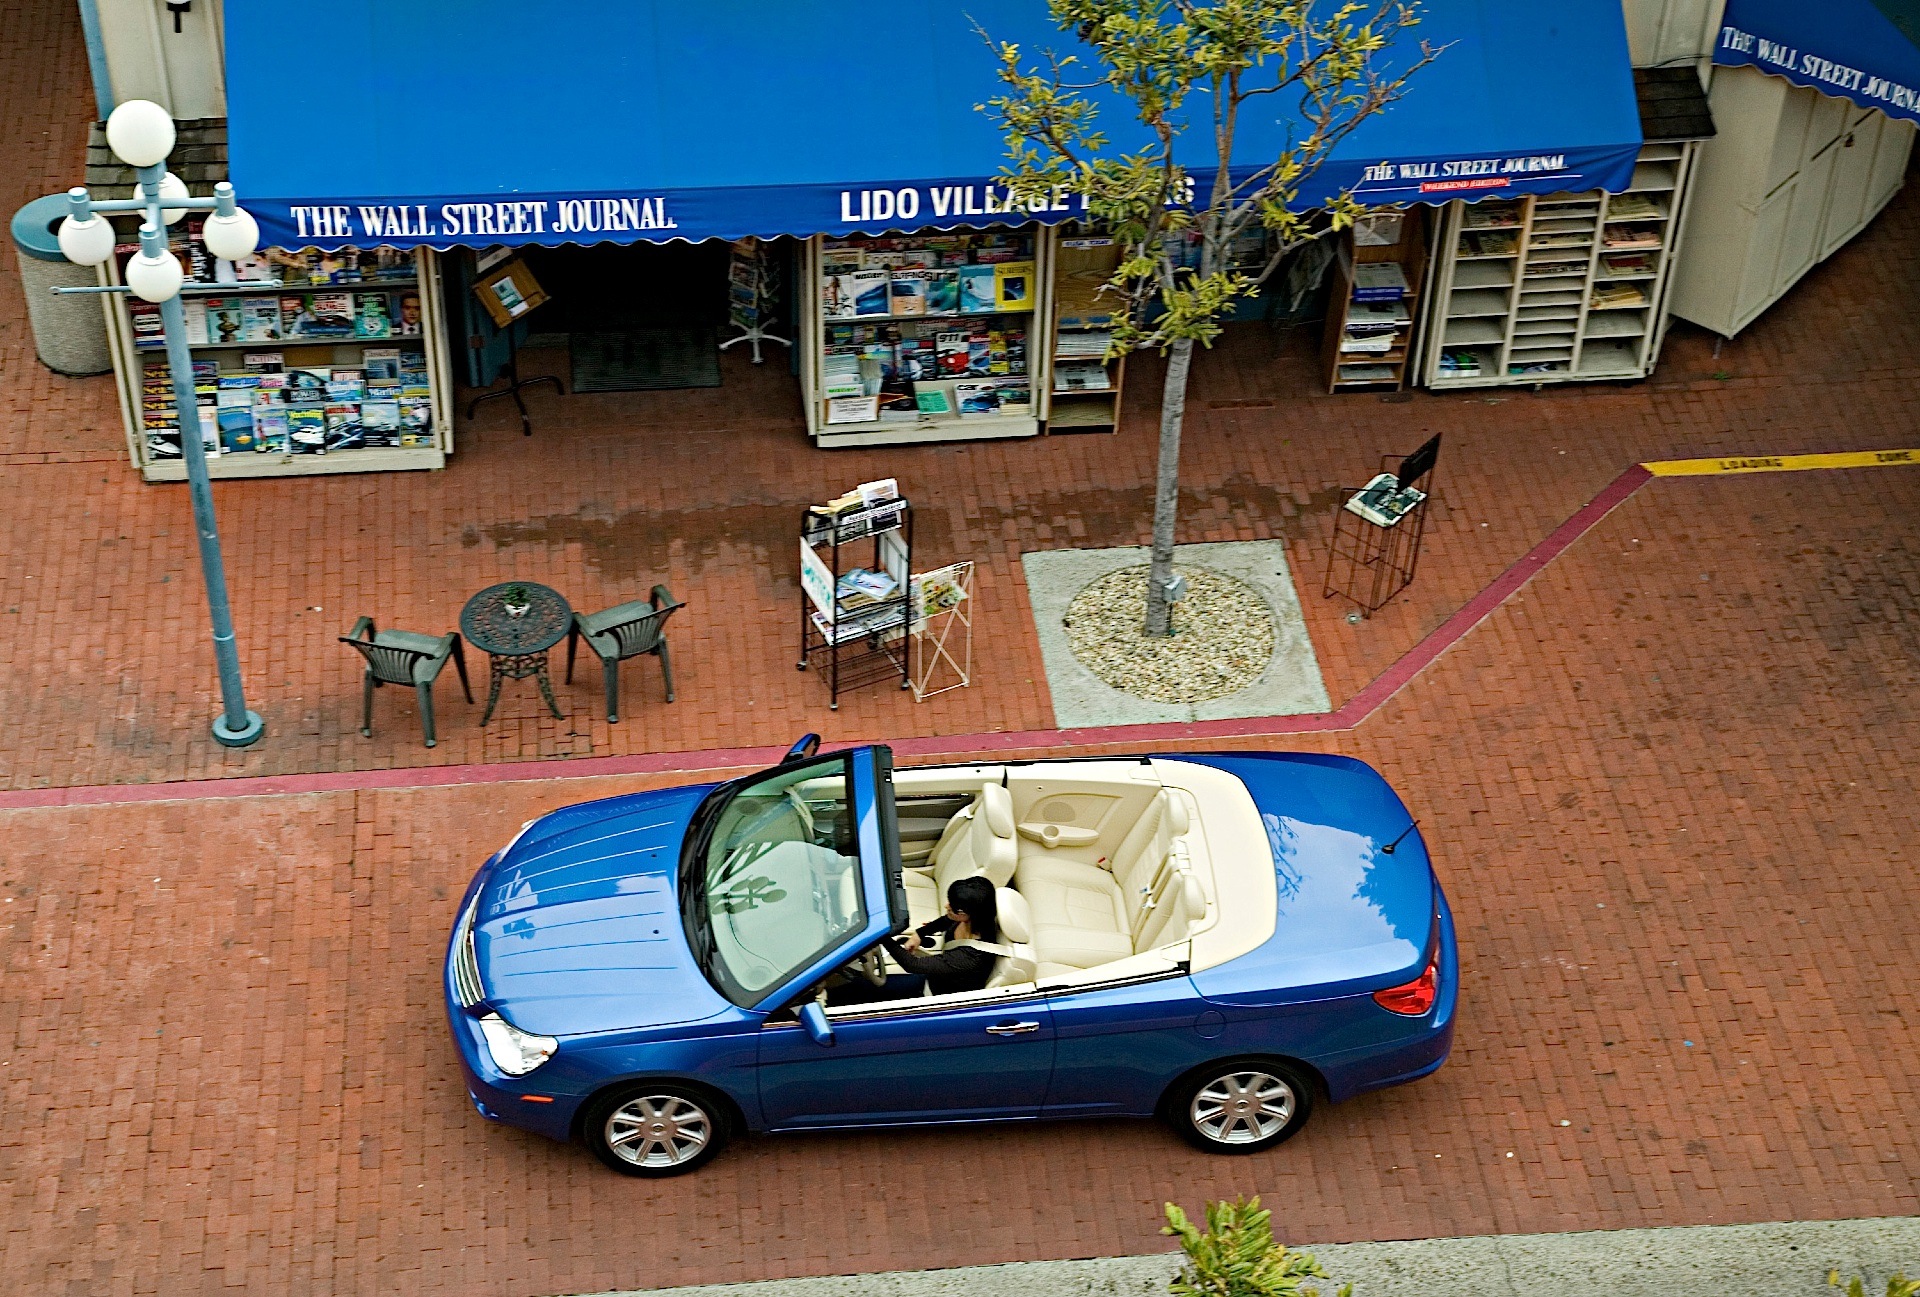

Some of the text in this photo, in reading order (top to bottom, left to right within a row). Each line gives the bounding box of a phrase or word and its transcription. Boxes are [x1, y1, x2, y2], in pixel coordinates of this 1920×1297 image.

[1722, 27, 1755, 54] THE
[1757, 38, 1798, 71] WALL
[1800, 54, 1865, 91] STREET
[1364, 165, 1396, 181] THE
[1400, 163, 1439, 178] WALL
[1441, 159, 1501, 176] STREET
[290, 206, 352, 238] THE
[356, 205, 435, 237] WALL
[442, 201, 548, 236] STREET
[841, 187, 919, 222] LIDO
